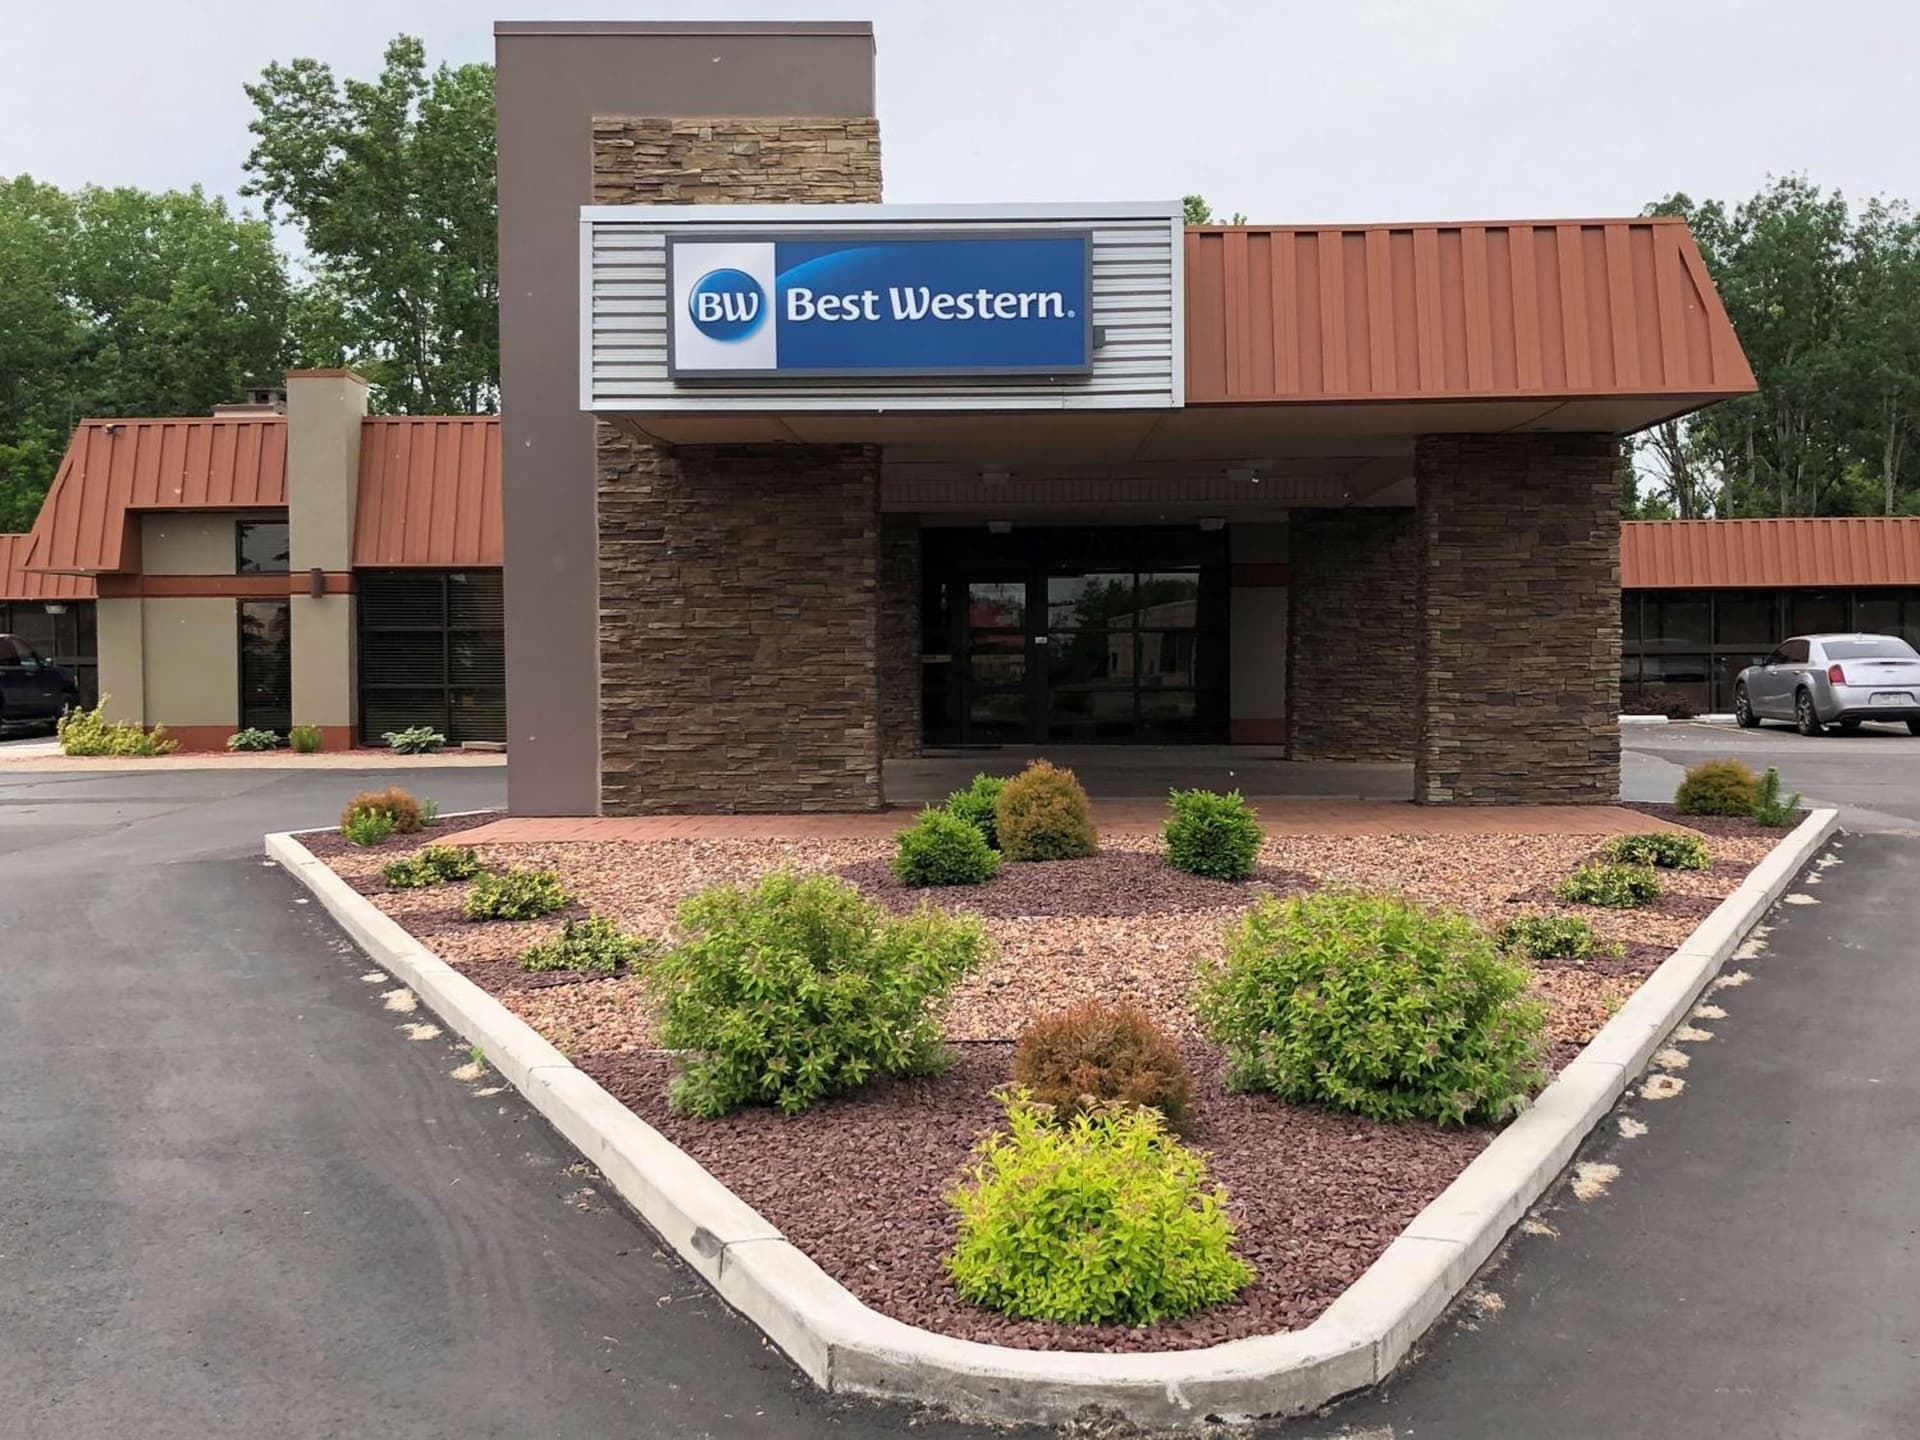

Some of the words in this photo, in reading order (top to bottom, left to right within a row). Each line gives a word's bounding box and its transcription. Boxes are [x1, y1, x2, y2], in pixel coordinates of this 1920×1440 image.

[698, 291, 759, 322] BW
[787, 287, 881, 321] Best
[889, 286, 1065, 320] Western
